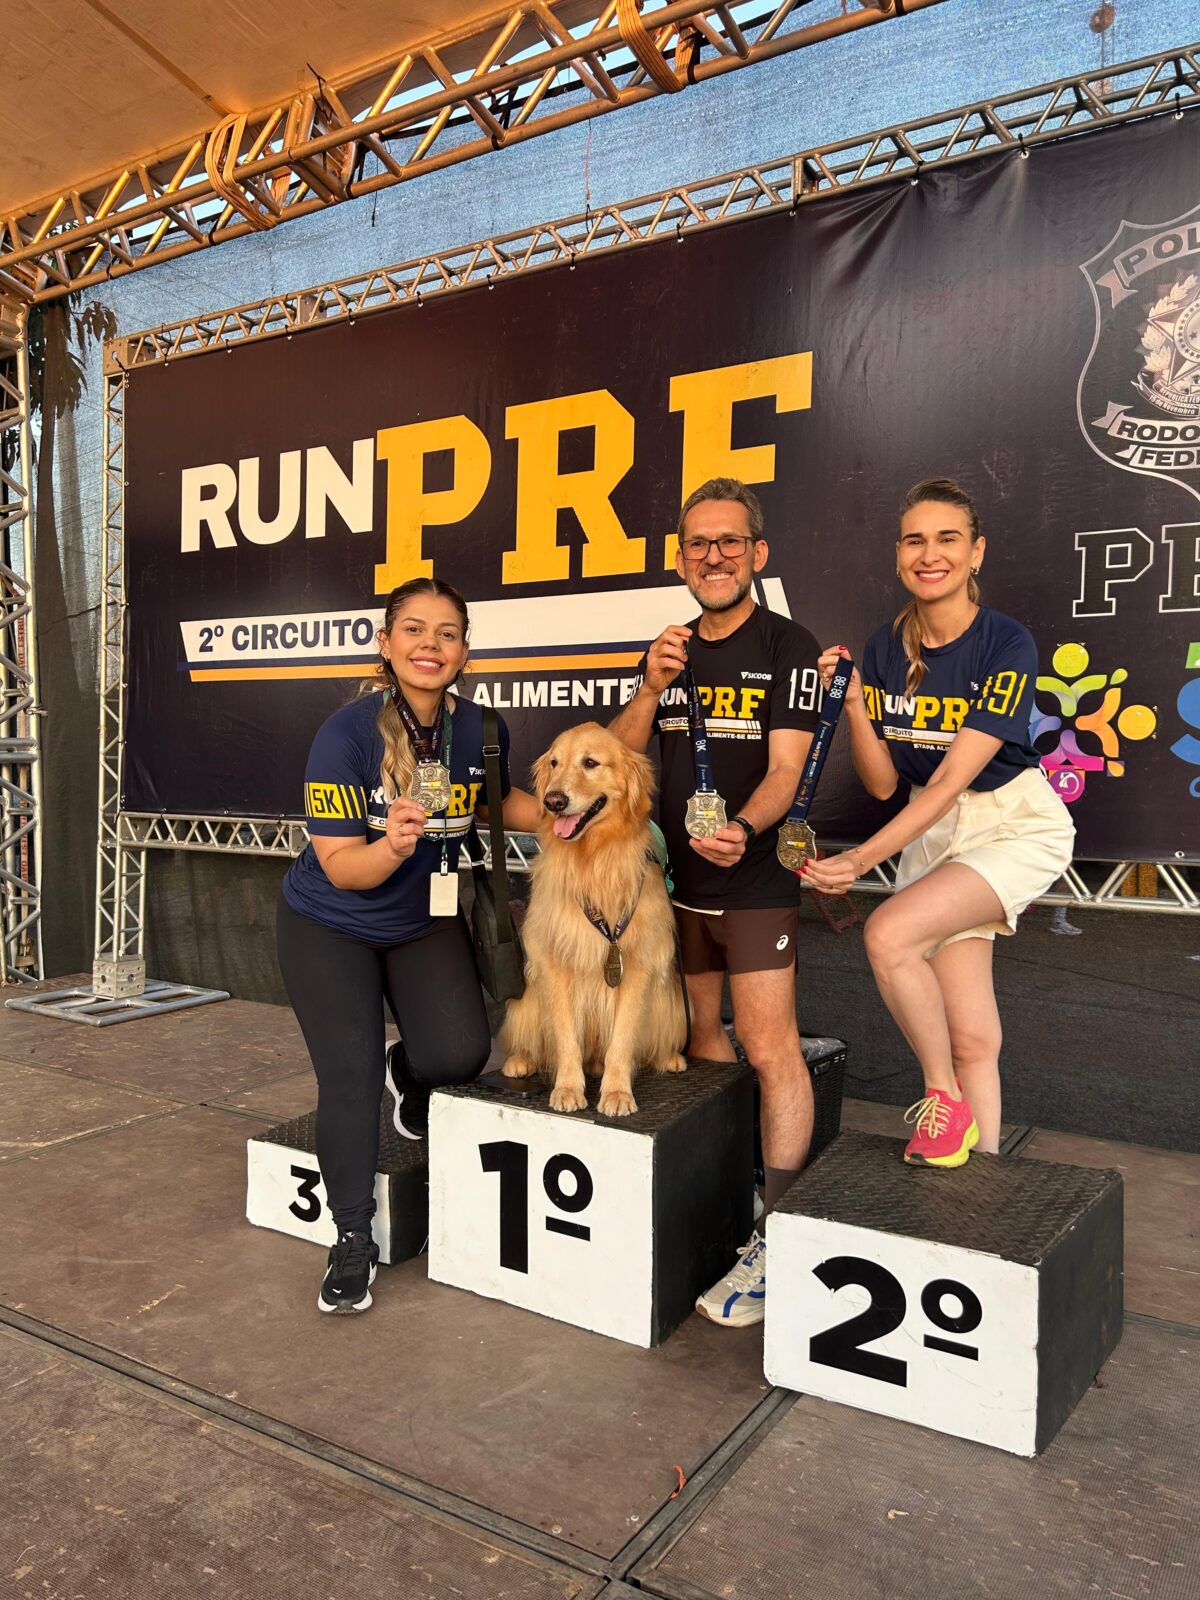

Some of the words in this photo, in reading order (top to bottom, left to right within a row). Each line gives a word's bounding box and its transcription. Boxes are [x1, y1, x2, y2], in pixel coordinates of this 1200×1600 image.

[1116, 422, 1200, 442] RODO
[181, 438, 375, 553] RUN
[374, 351, 812, 595] PRF
[1138, 448, 1200, 467] FED
[199, 625, 224, 653] 2º
[232, 617, 373, 651] CIRCUITO
[747, 672, 772, 680] SICOOB
[885, 695, 916, 716] UN
[912, 696, 970, 731] PR
[312, 788, 341, 814] 5K
[478, 1140, 594, 1275] 1º
[809, 1255, 983, 1388] 2º
